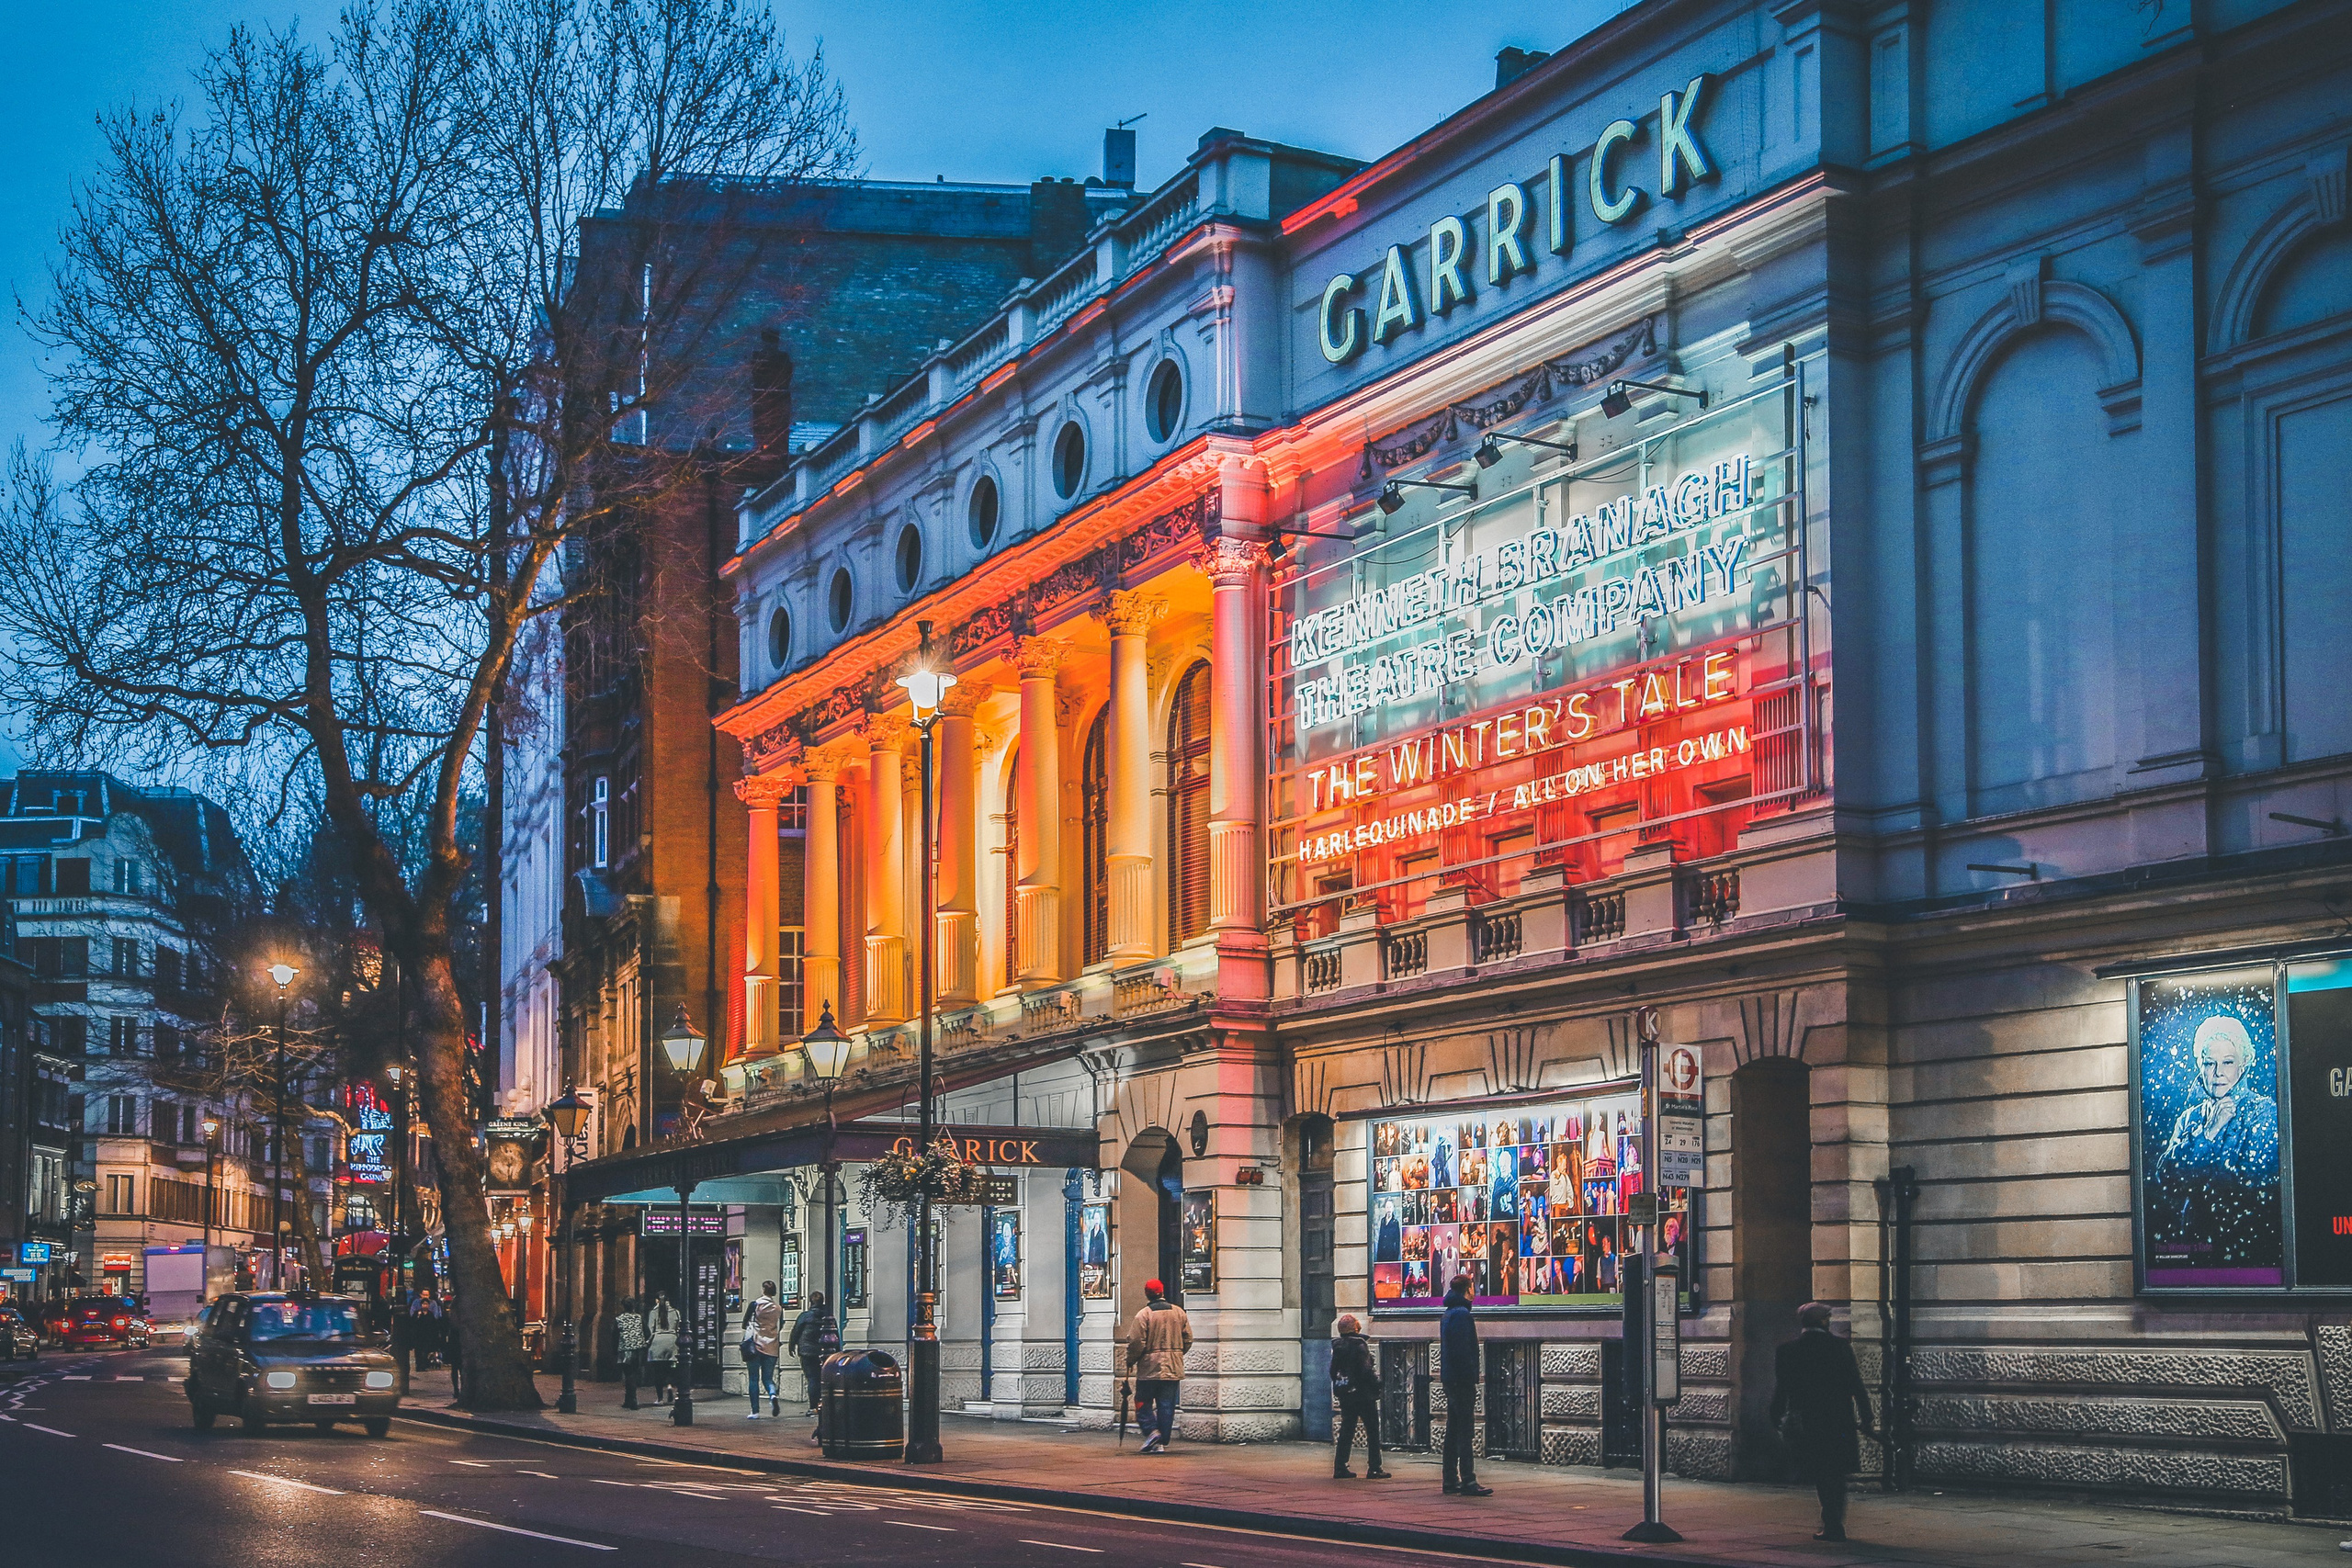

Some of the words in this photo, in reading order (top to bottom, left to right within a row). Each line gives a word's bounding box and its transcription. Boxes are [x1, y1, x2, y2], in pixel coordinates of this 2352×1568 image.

[1318, 73, 1714, 364] GARRICK
[1291, 553, 1482, 667] KENNETH
[1494, 453, 1748, 593] BRANAGH
[1295, 628, 1478, 730] THEATRE
[1487, 535, 1747, 669] COMPANY
[1307, 756, 1375, 808] THE
[1390, 693, 1591, 784] WINTER'S
[1612, 651, 1731, 723] TALE
[1299, 797, 1472, 862] HARLEQUINADE
[1513, 777, 1556, 808] ALL
[1565, 761, 1600, 795] ON
[1612, 748, 1664, 781] HER
[1678, 726, 1746, 766] OWN
[1645, 1011, 1659, 1035] K
[366, 1155, 380, 1163] THE
[893, 1137, 1041, 1163] GRRICK
[1664, 1155, 1672, 1163] N5
[1677, 1156, 1688, 1164] N20
[1690, 1156, 1701, 1165] N29
[1675, 1172, 1690, 1181] N279
